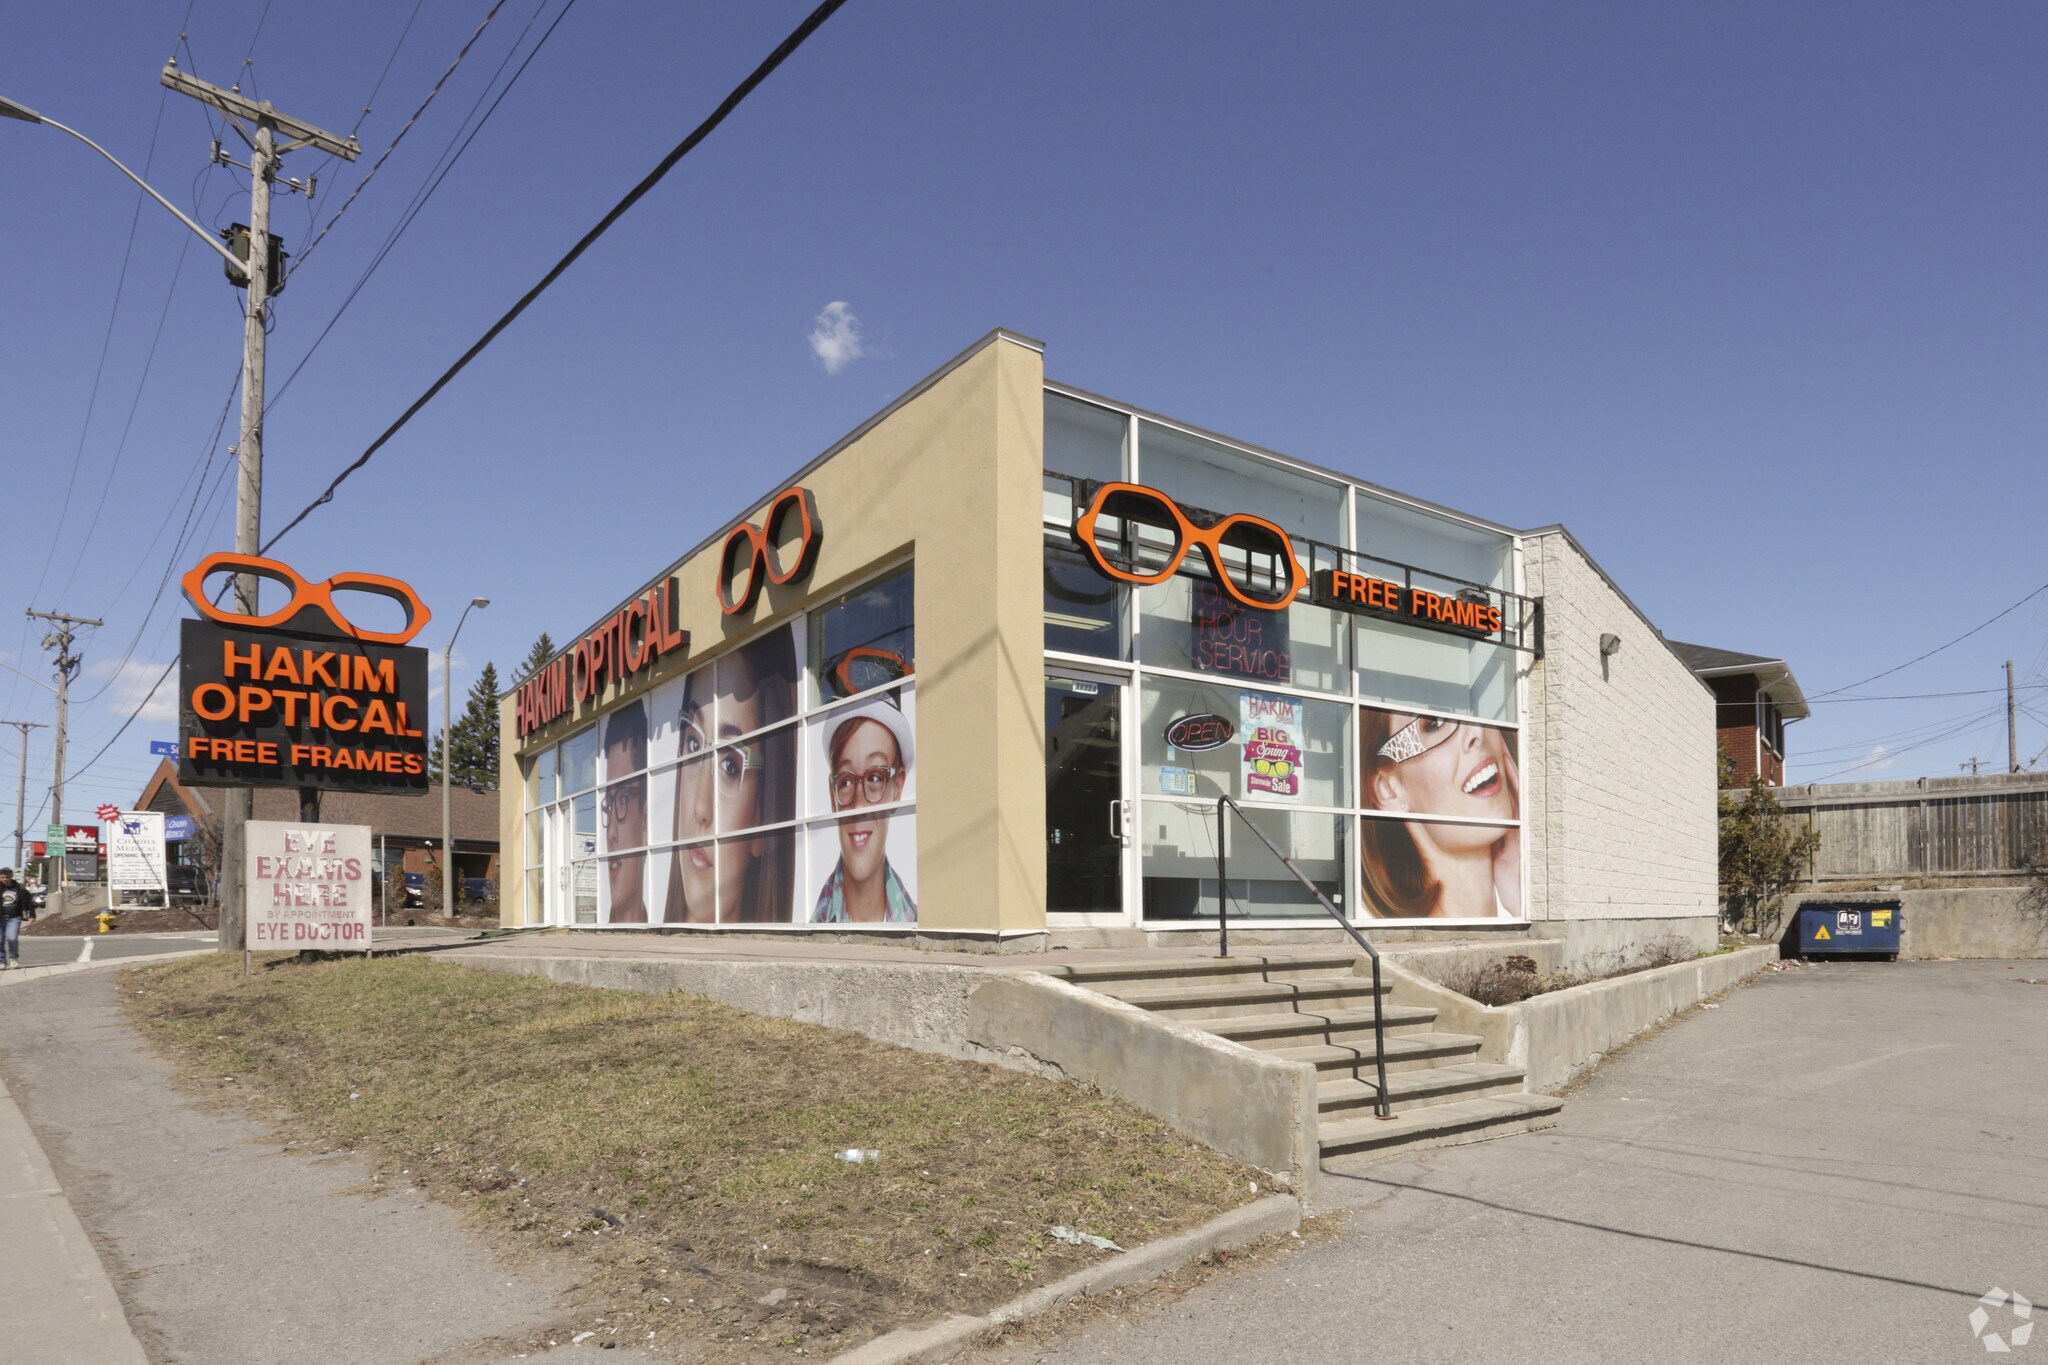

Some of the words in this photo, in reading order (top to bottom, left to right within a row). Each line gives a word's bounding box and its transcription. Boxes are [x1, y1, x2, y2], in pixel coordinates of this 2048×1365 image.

[1332, 569, 1399, 611] FREE
[1412, 588, 1502, 633] FRAMES
[1199, 608, 1262, 646] HOUR
[223, 639, 395, 695] HAKIM
[515, 652, 567, 740] HAKIM
[574, 575, 682, 704] OPTICAL
[1197, 639, 1291, 680] SERVICE
[191, 682, 423, 738] OPTICAL
[1249, 696, 1294, 719] HAKIM
[1171, 720, 1233, 743] OPEN
[1257, 727, 1288, 743] BIG
[188, 736, 279, 765] FREE
[291, 744, 423, 775] FRAMES
[1256, 740, 1289, 761] Spring
[1271, 777, 1291, 794] Sale
[284, 830, 336, 854] EYE
[256, 855, 362, 881] EXAMS
[273, 883, 348, 907] HERE
[267, 910, 280, 918] BY
[283, 910, 356, 919] APPOINTMENT
[256, 922, 289, 940] EYE
[294, 922, 366, 940] DOCTOR
